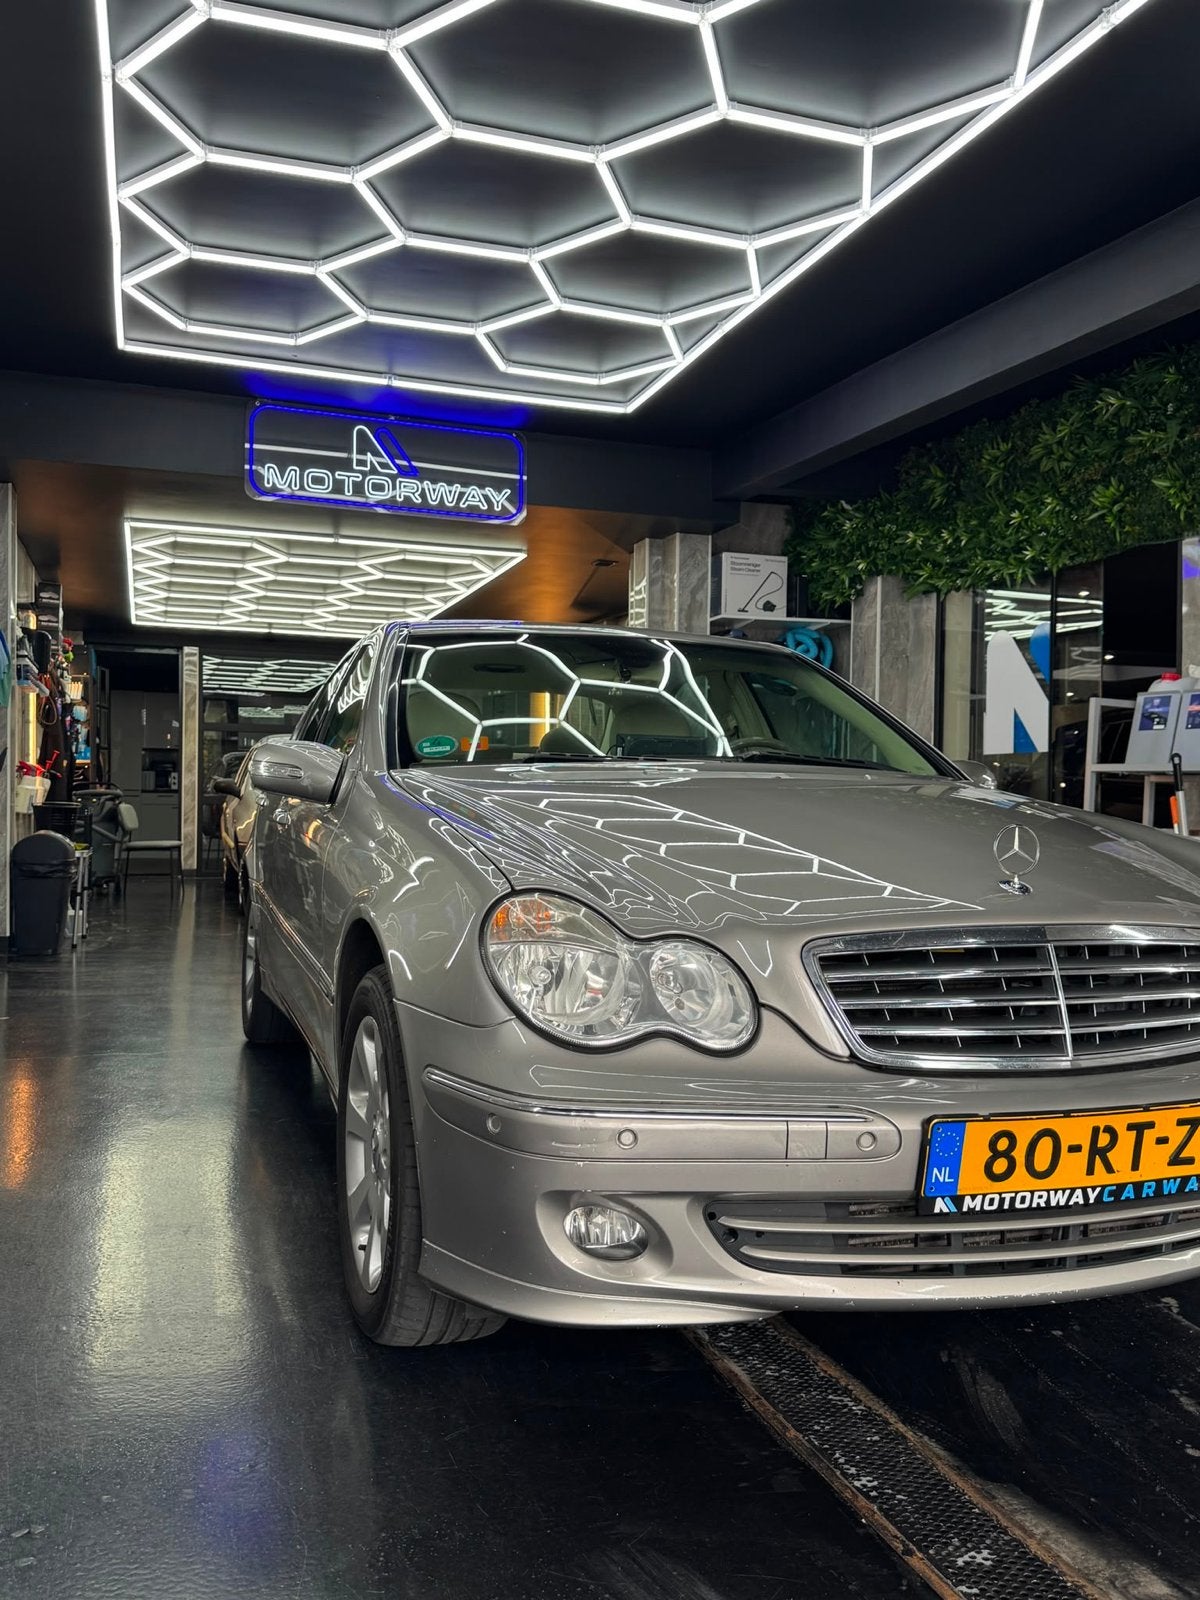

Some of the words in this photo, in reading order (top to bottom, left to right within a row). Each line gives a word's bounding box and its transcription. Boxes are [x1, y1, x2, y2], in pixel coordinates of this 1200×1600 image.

[263, 463, 511, 511] MOTORWAY
[983, 1116, 1200, 1183] 80-RT-Z
[931, 1167, 954, 1183] NL
